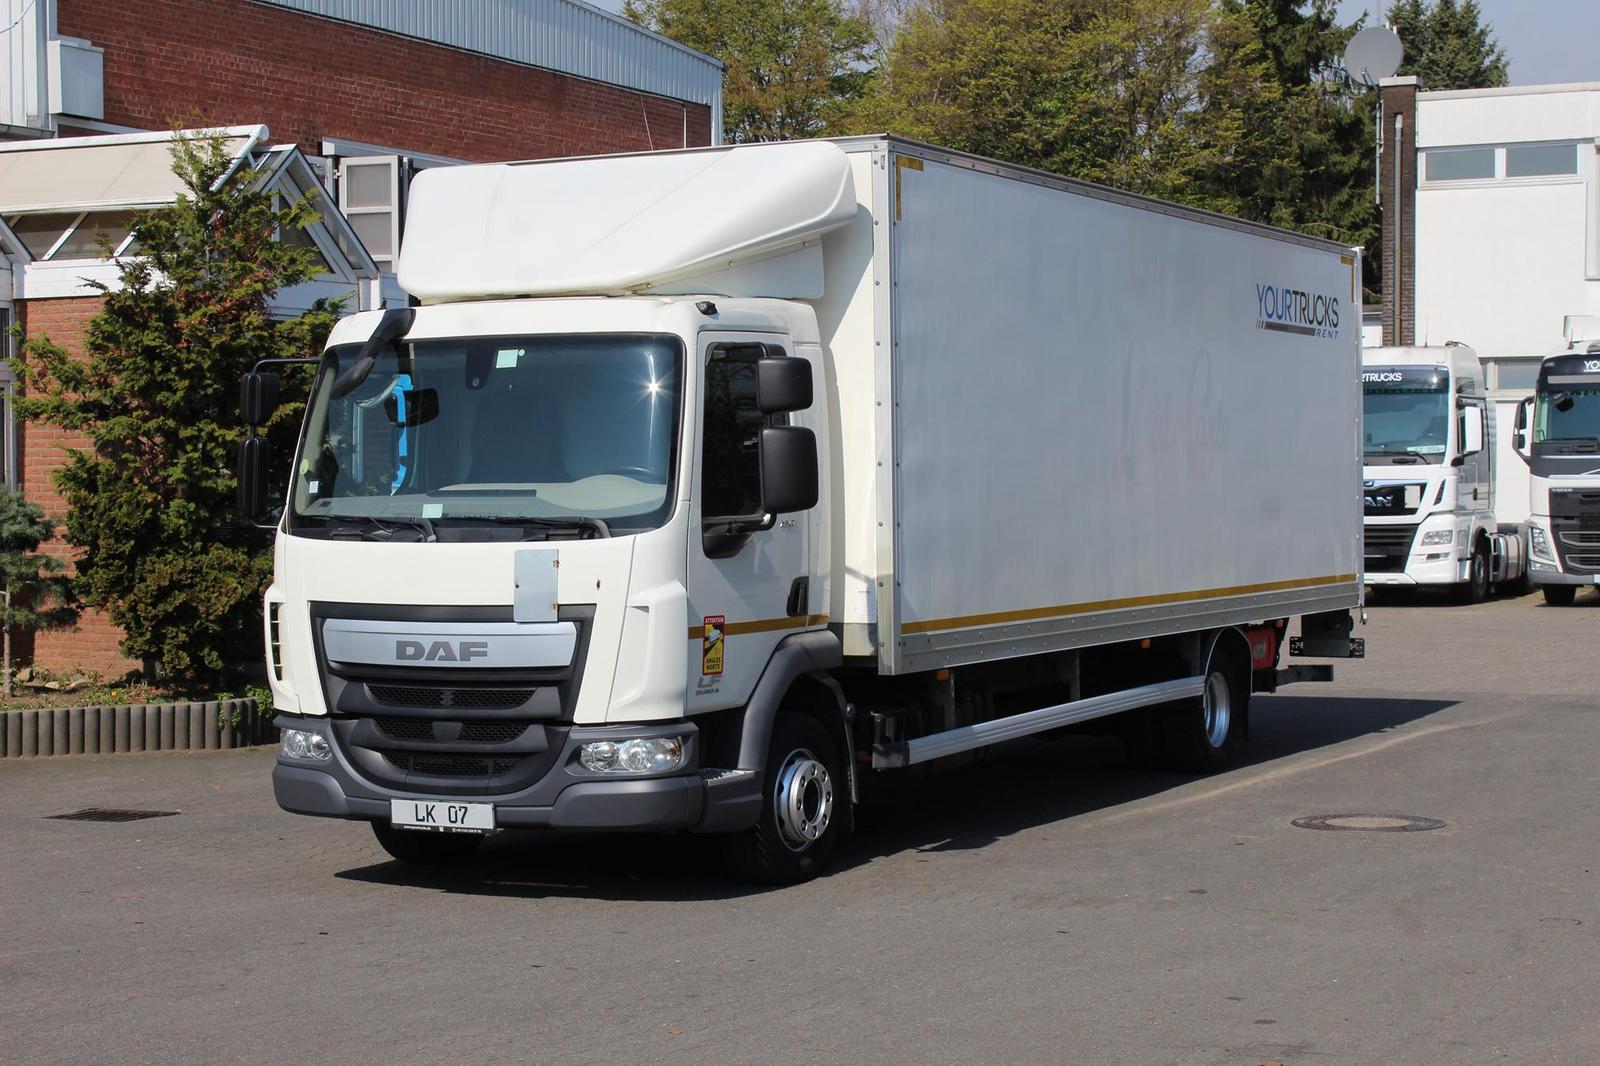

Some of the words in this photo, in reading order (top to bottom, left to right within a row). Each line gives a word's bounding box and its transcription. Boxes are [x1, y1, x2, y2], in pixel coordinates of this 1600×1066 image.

[1256, 283, 1339, 328] YOURTRUCKS
[1316, 328, 1339, 340] RENT
[1583, 360, 1600, 370] YO
[396, 640, 488, 662] DAF
[415, 803, 436, 823] LK
[448, 805, 469, 825] 07
